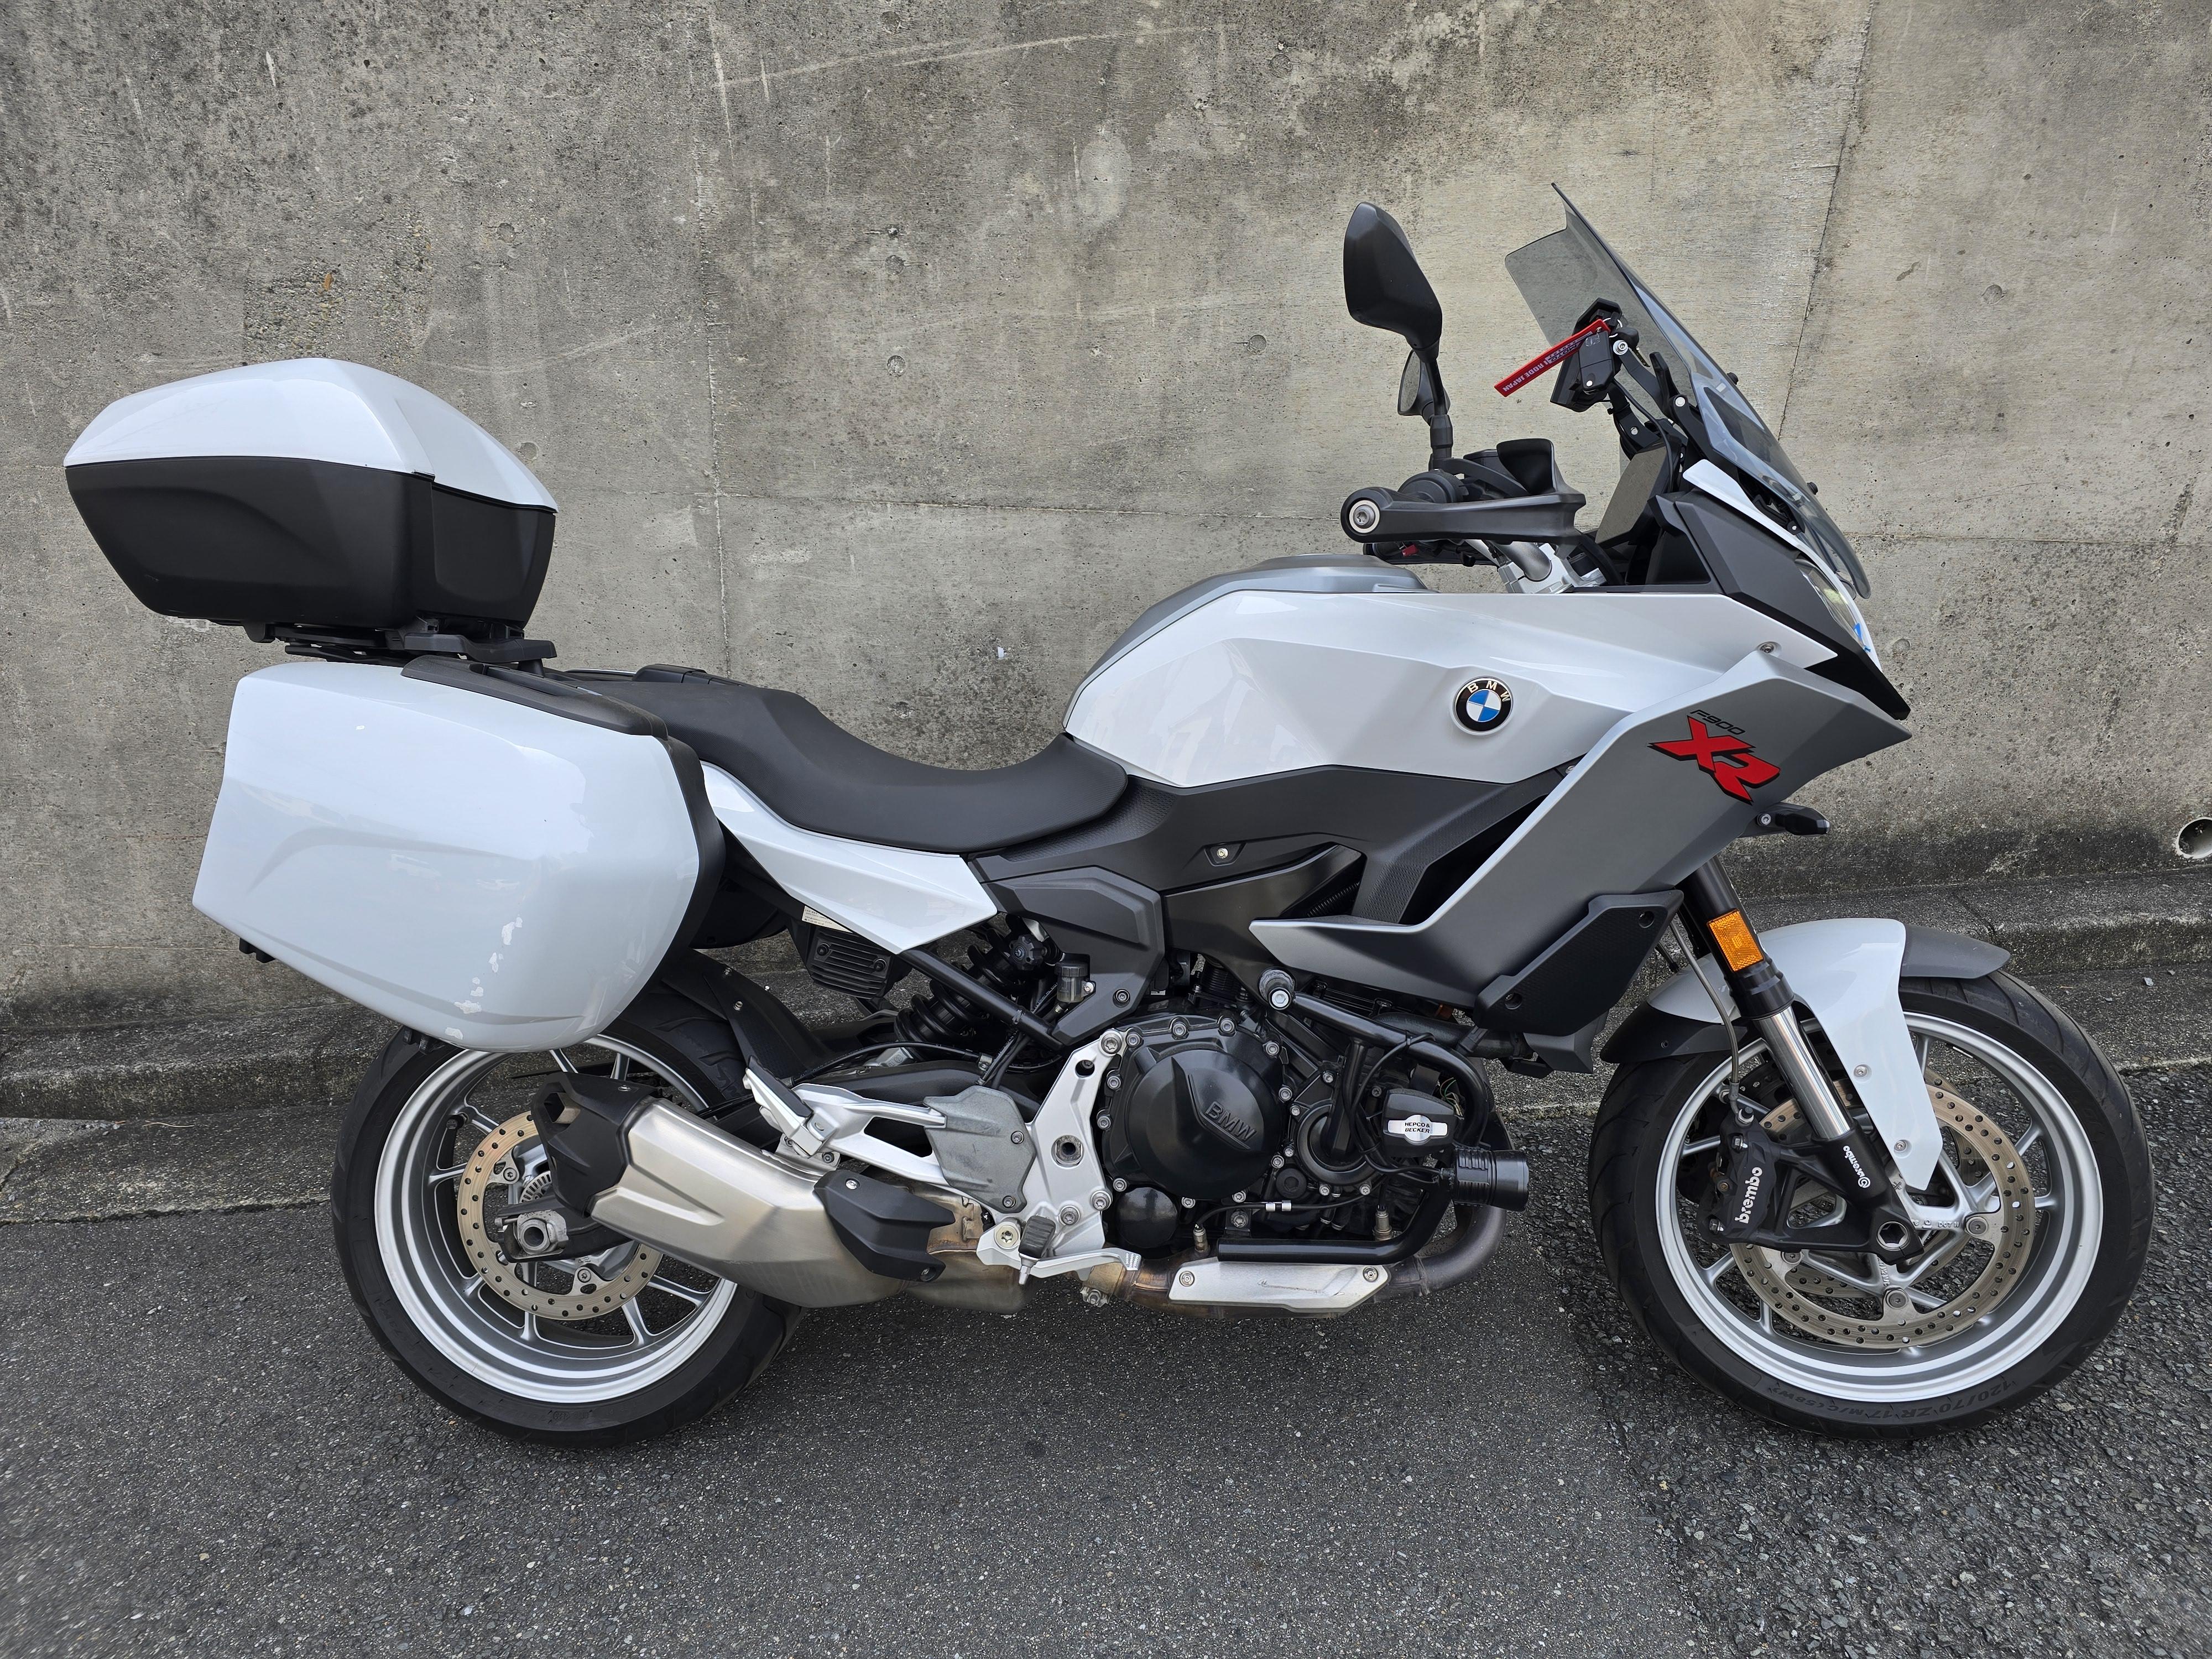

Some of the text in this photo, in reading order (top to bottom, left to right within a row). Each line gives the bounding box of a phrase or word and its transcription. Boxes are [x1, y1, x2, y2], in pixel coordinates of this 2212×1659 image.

[1524, 363, 1545, 378] RODE
[1502, 374, 1525, 392] JAPAN
[1467, 680, 1511, 702] BMW
[1646, 716, 1781, 806] XR
[1205, 1100, 1258, 1141] BMW
[1843, 1145, 1865, 1178] brembo
[1734, 1166, 1763, 1224] brembo
[1939, 1381, 2011, 1413] 120/70
[1827, 1405, 1864, 1416] M/C
[1869, 1410, 1893, 1419] 17
[1901, 1406, 1933, 1418] ZR
